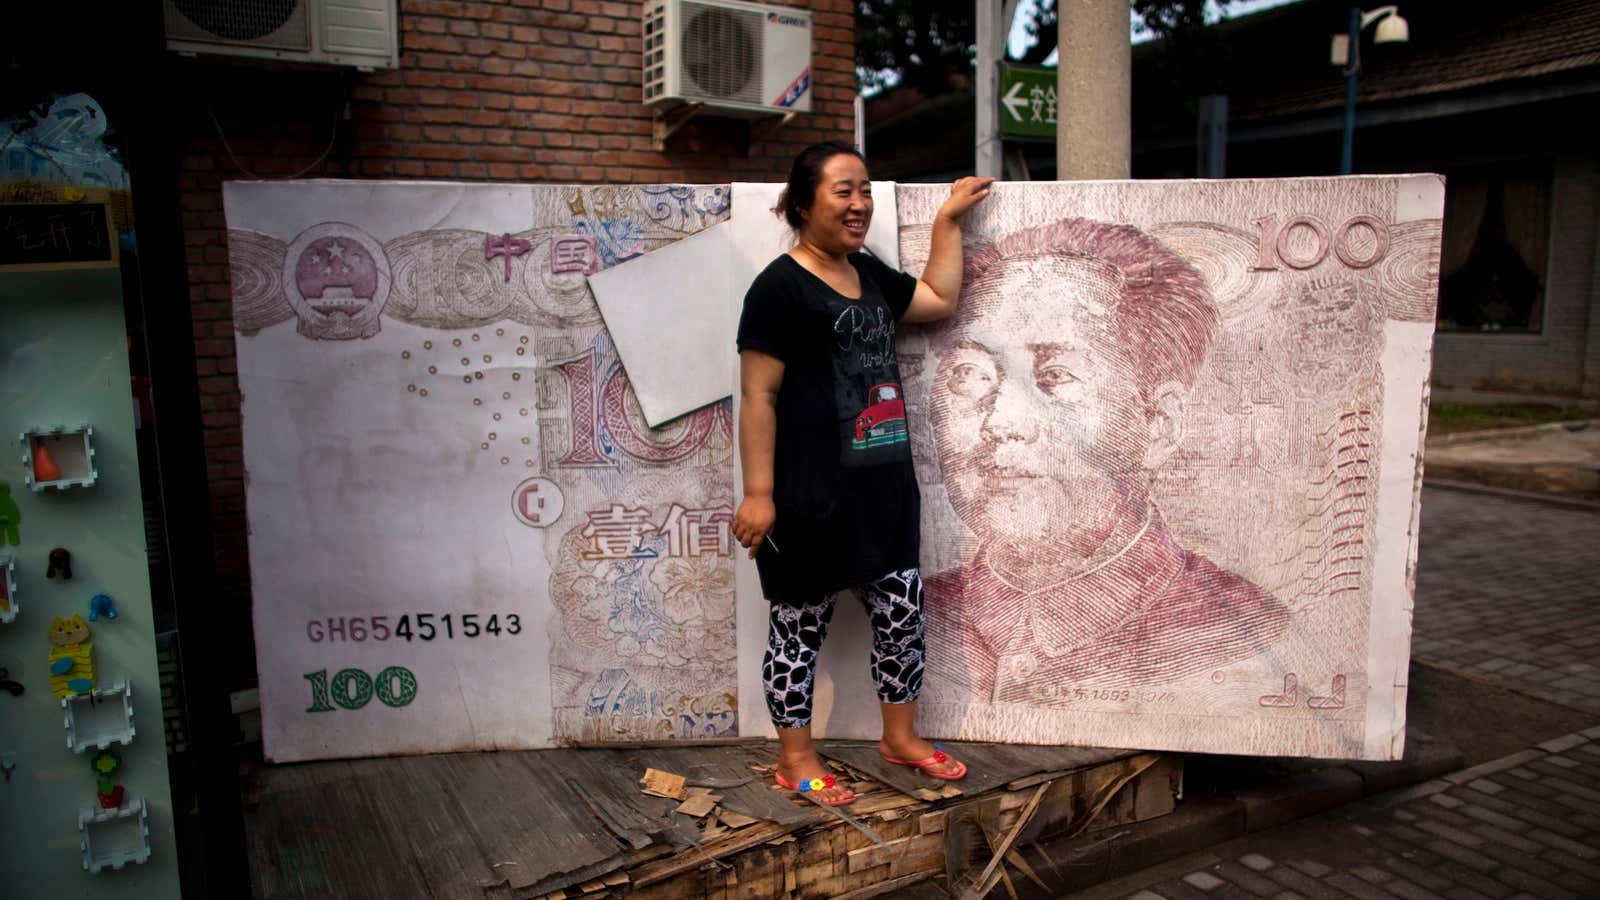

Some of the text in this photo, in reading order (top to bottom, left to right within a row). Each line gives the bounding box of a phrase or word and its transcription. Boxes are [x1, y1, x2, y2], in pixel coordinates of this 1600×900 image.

[1247, 212, 1392, 273] 100
[580, 502, 733, 560] 壹佰
[306, 613, 522, 642] GH65451543
[303, 665, 418, 714] 100
